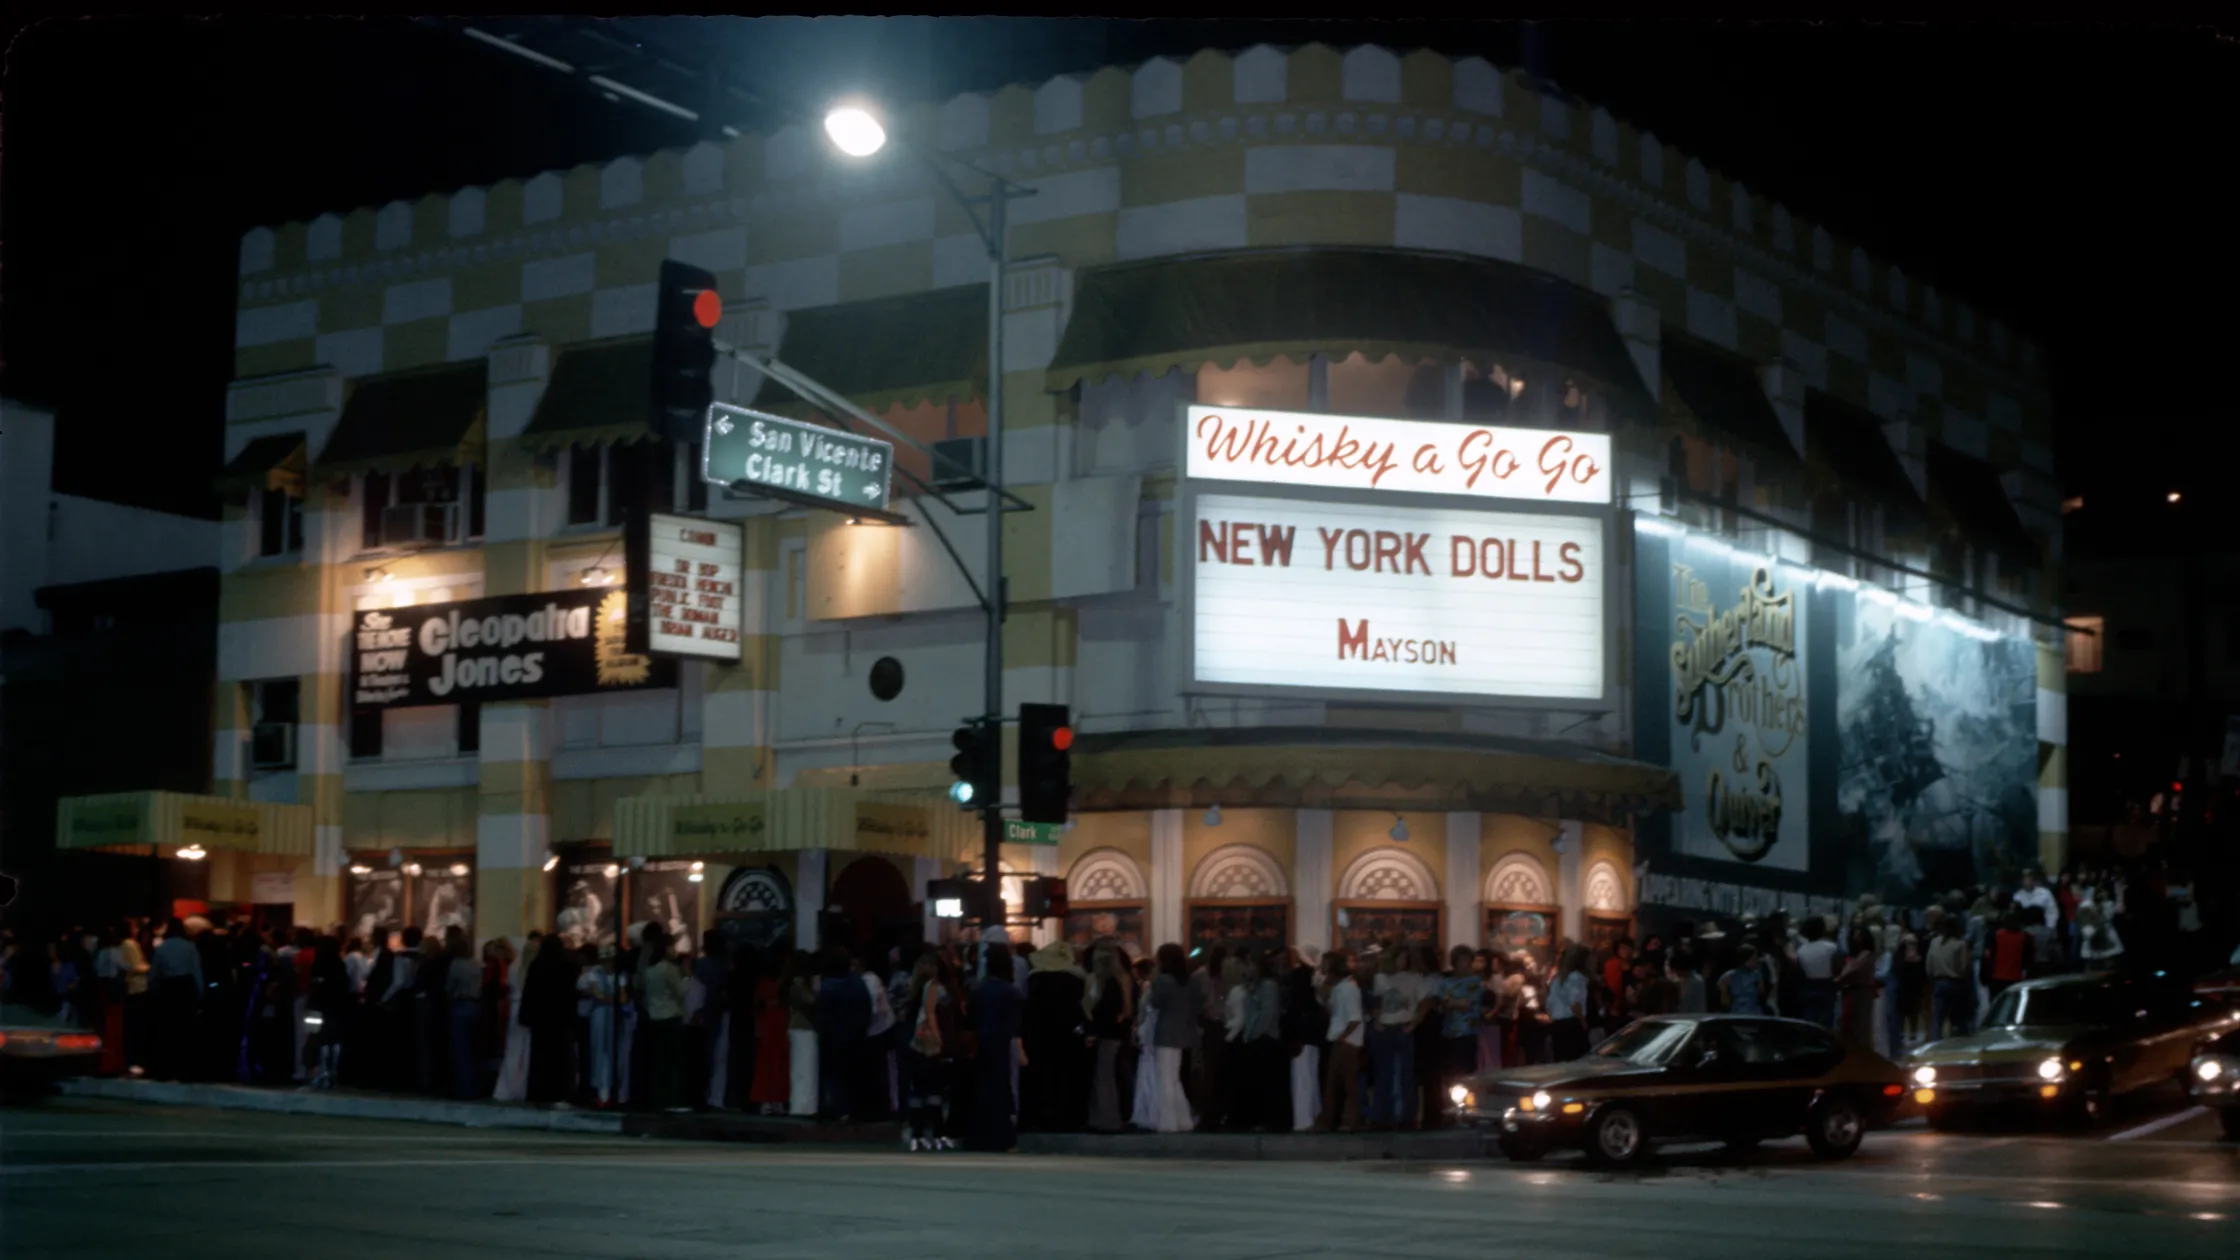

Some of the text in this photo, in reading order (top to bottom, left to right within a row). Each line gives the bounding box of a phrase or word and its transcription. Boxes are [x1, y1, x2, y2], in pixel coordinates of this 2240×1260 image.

[748, 420, 883, 473] San Vicente
[1196, 414, 1600, 494] Whisky a Go Go
[745, 453, 843, 498] Clark St
[1199, 518, 1584, 583] NEW YORK DOLLS
[428, 652, 545, 697] Jones
[1733, 733, 1749, 774] &
[1008, 824, 1037, 840] Clark
